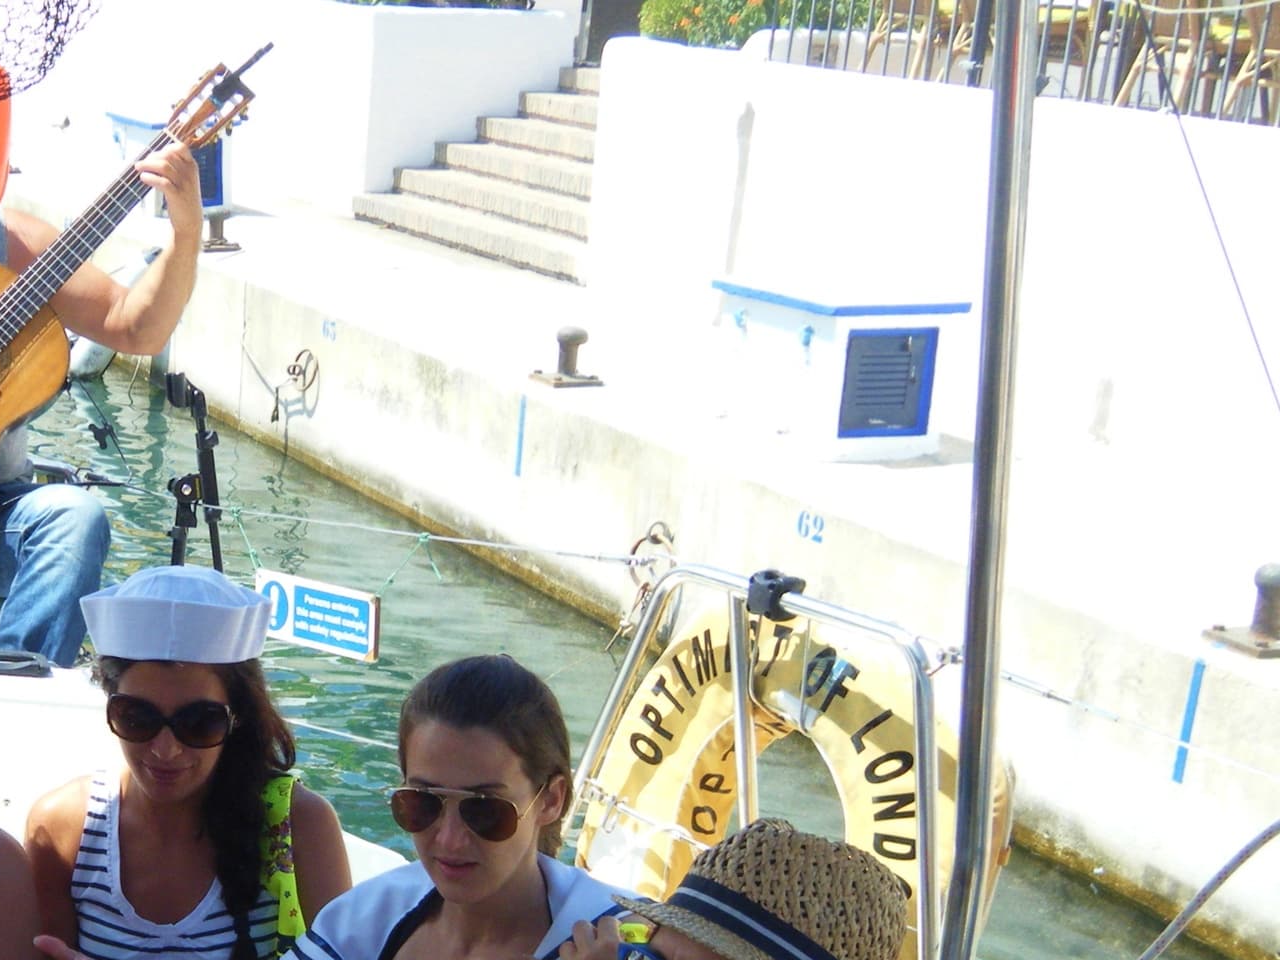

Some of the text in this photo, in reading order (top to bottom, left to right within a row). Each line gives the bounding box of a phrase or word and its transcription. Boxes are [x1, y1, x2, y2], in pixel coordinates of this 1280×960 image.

[798, 509, 825, 544] 62
[296, 606, 367, 632] this area must comply
[304, 594, 360, 618] Persons entering
[295, 620, 368, 645] with safety regulations
[804, 646, 861, 713] OF
[850, 708, 917, 899] LOND
